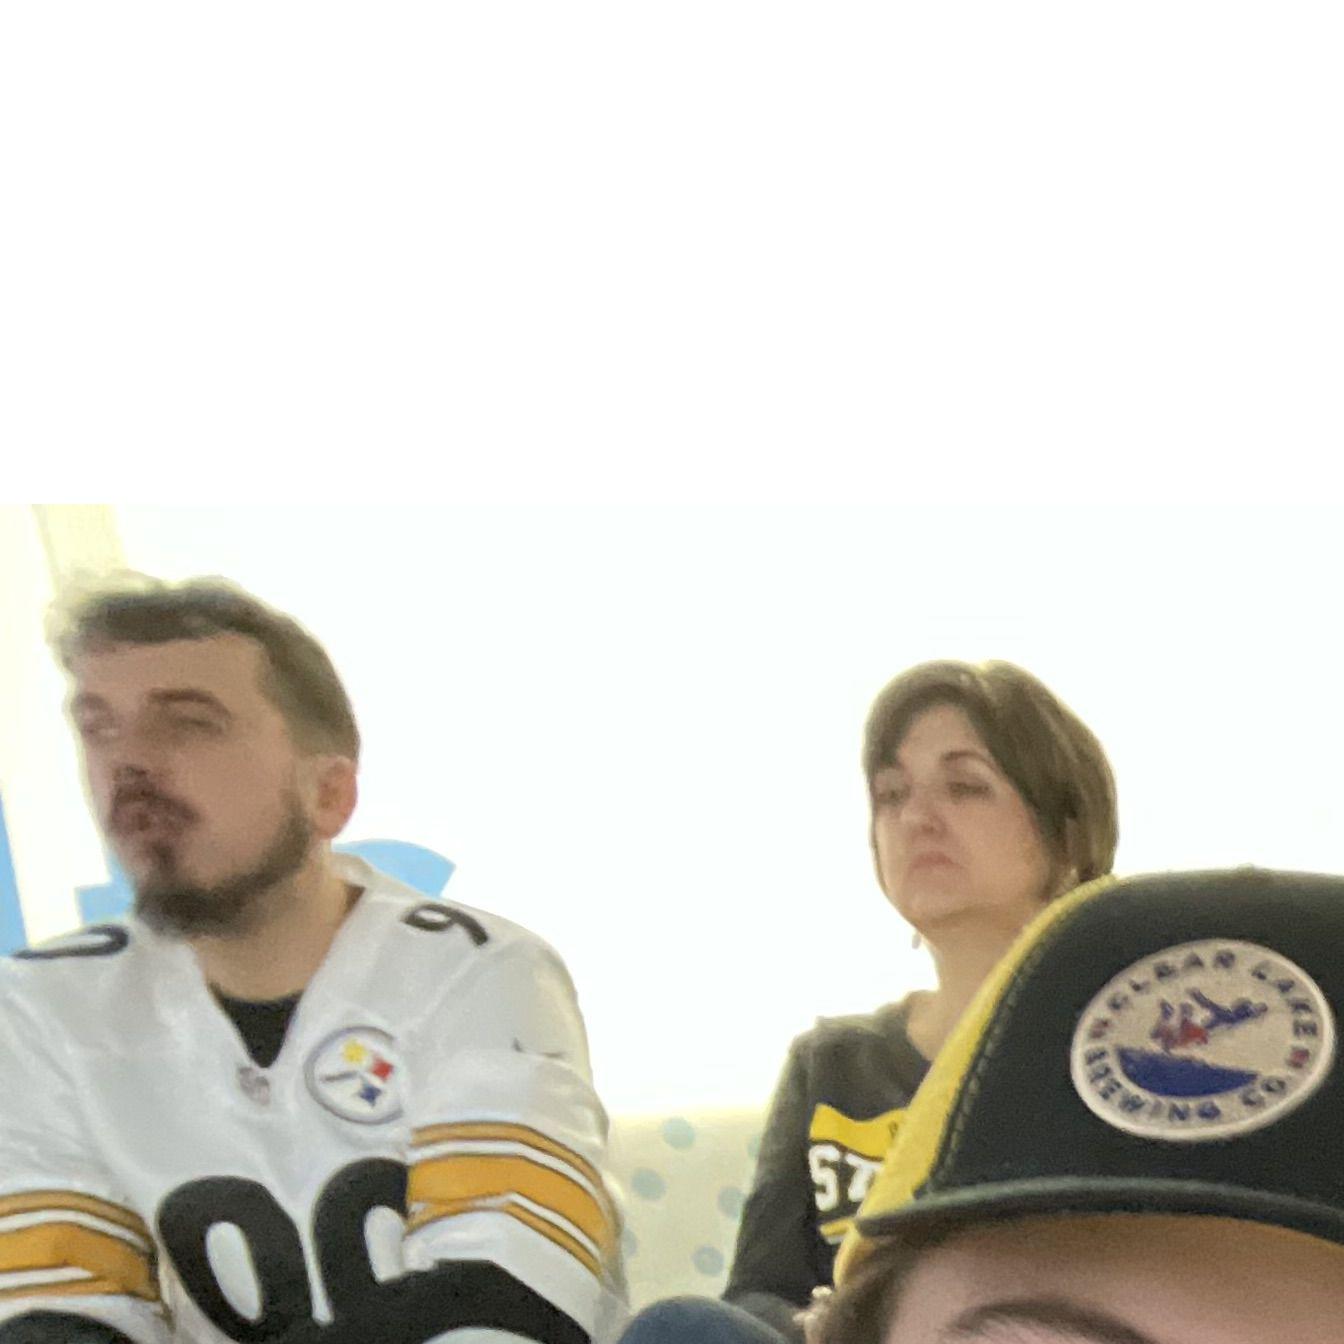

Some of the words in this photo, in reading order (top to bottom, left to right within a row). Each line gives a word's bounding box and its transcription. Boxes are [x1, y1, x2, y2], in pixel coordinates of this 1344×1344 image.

[1108, 950, 1236, 1012] CLEAR
[1250, 961, 1319, 1036] LAKE
[808, 1143, 884, 1213] ST
